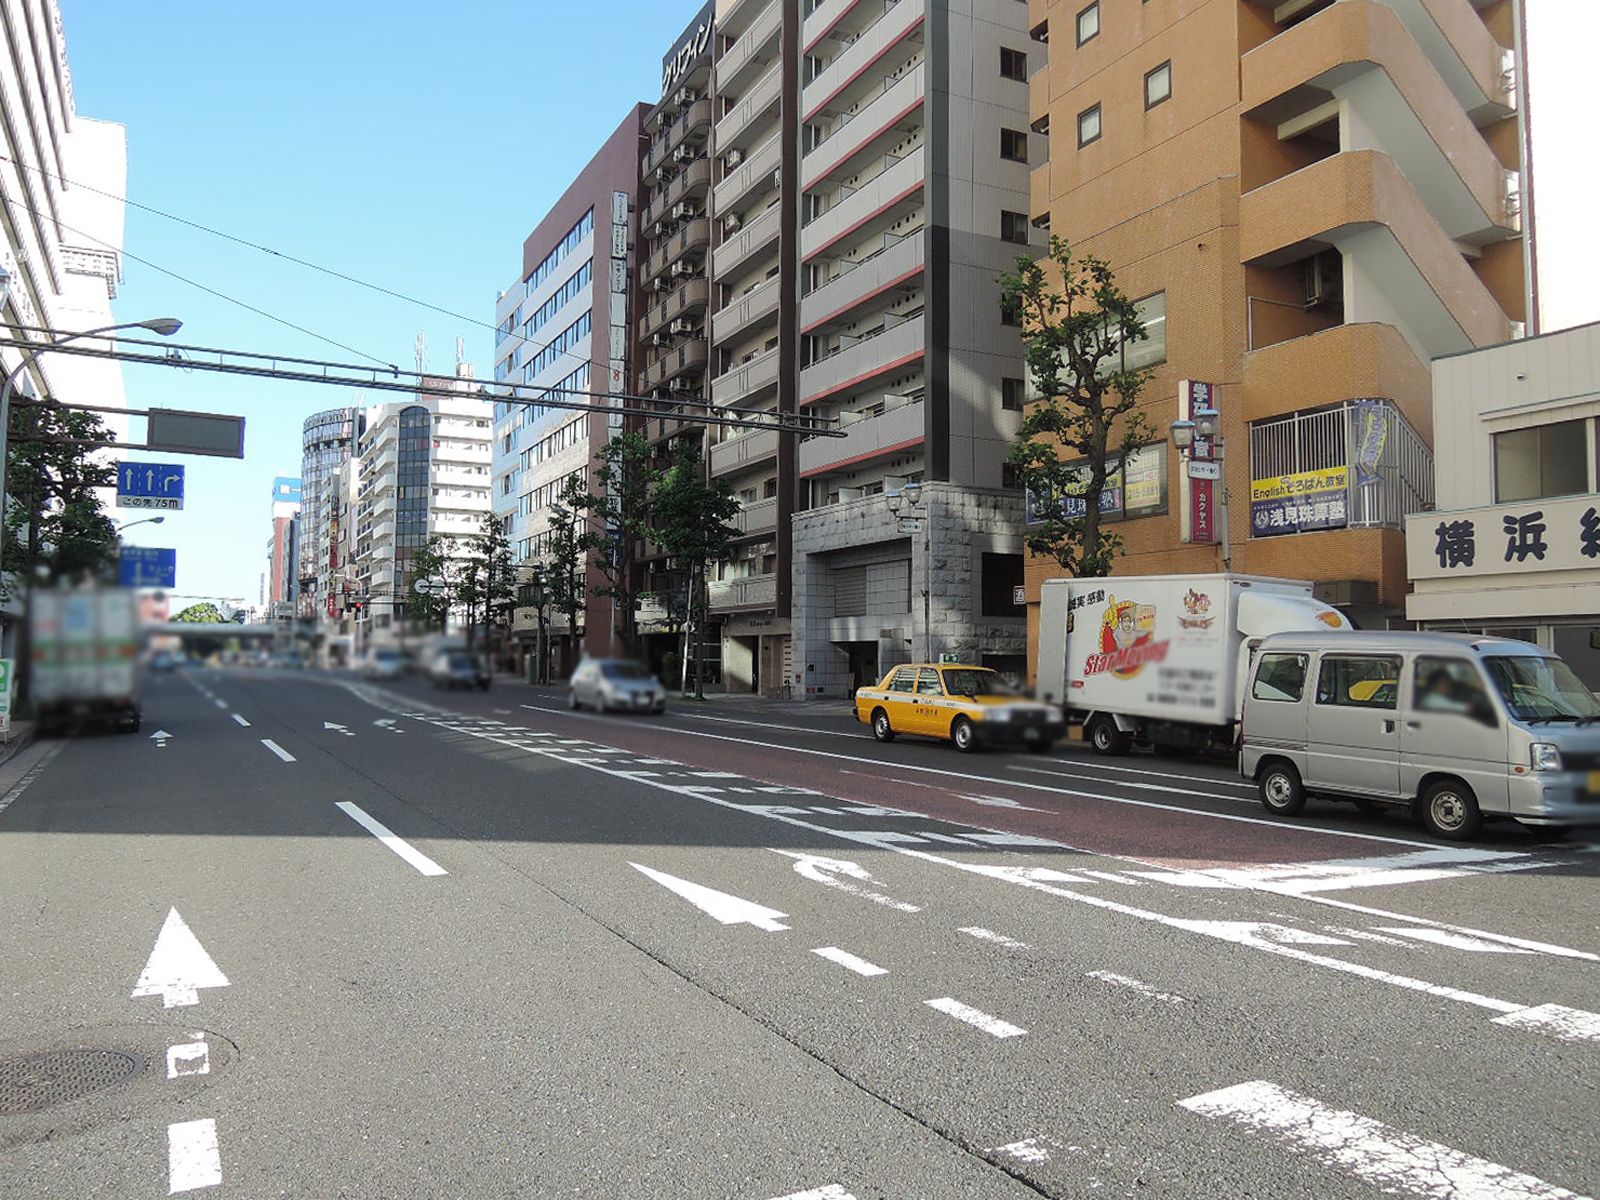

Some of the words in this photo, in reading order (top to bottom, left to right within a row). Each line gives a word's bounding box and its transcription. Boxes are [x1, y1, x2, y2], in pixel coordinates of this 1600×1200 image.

[1254, 485, 1285, 499] English
[123, 498, 152, 507] この先
[155, 499, 179, 509] 75m
[1198, 492, 1207, 529] カクヤス
